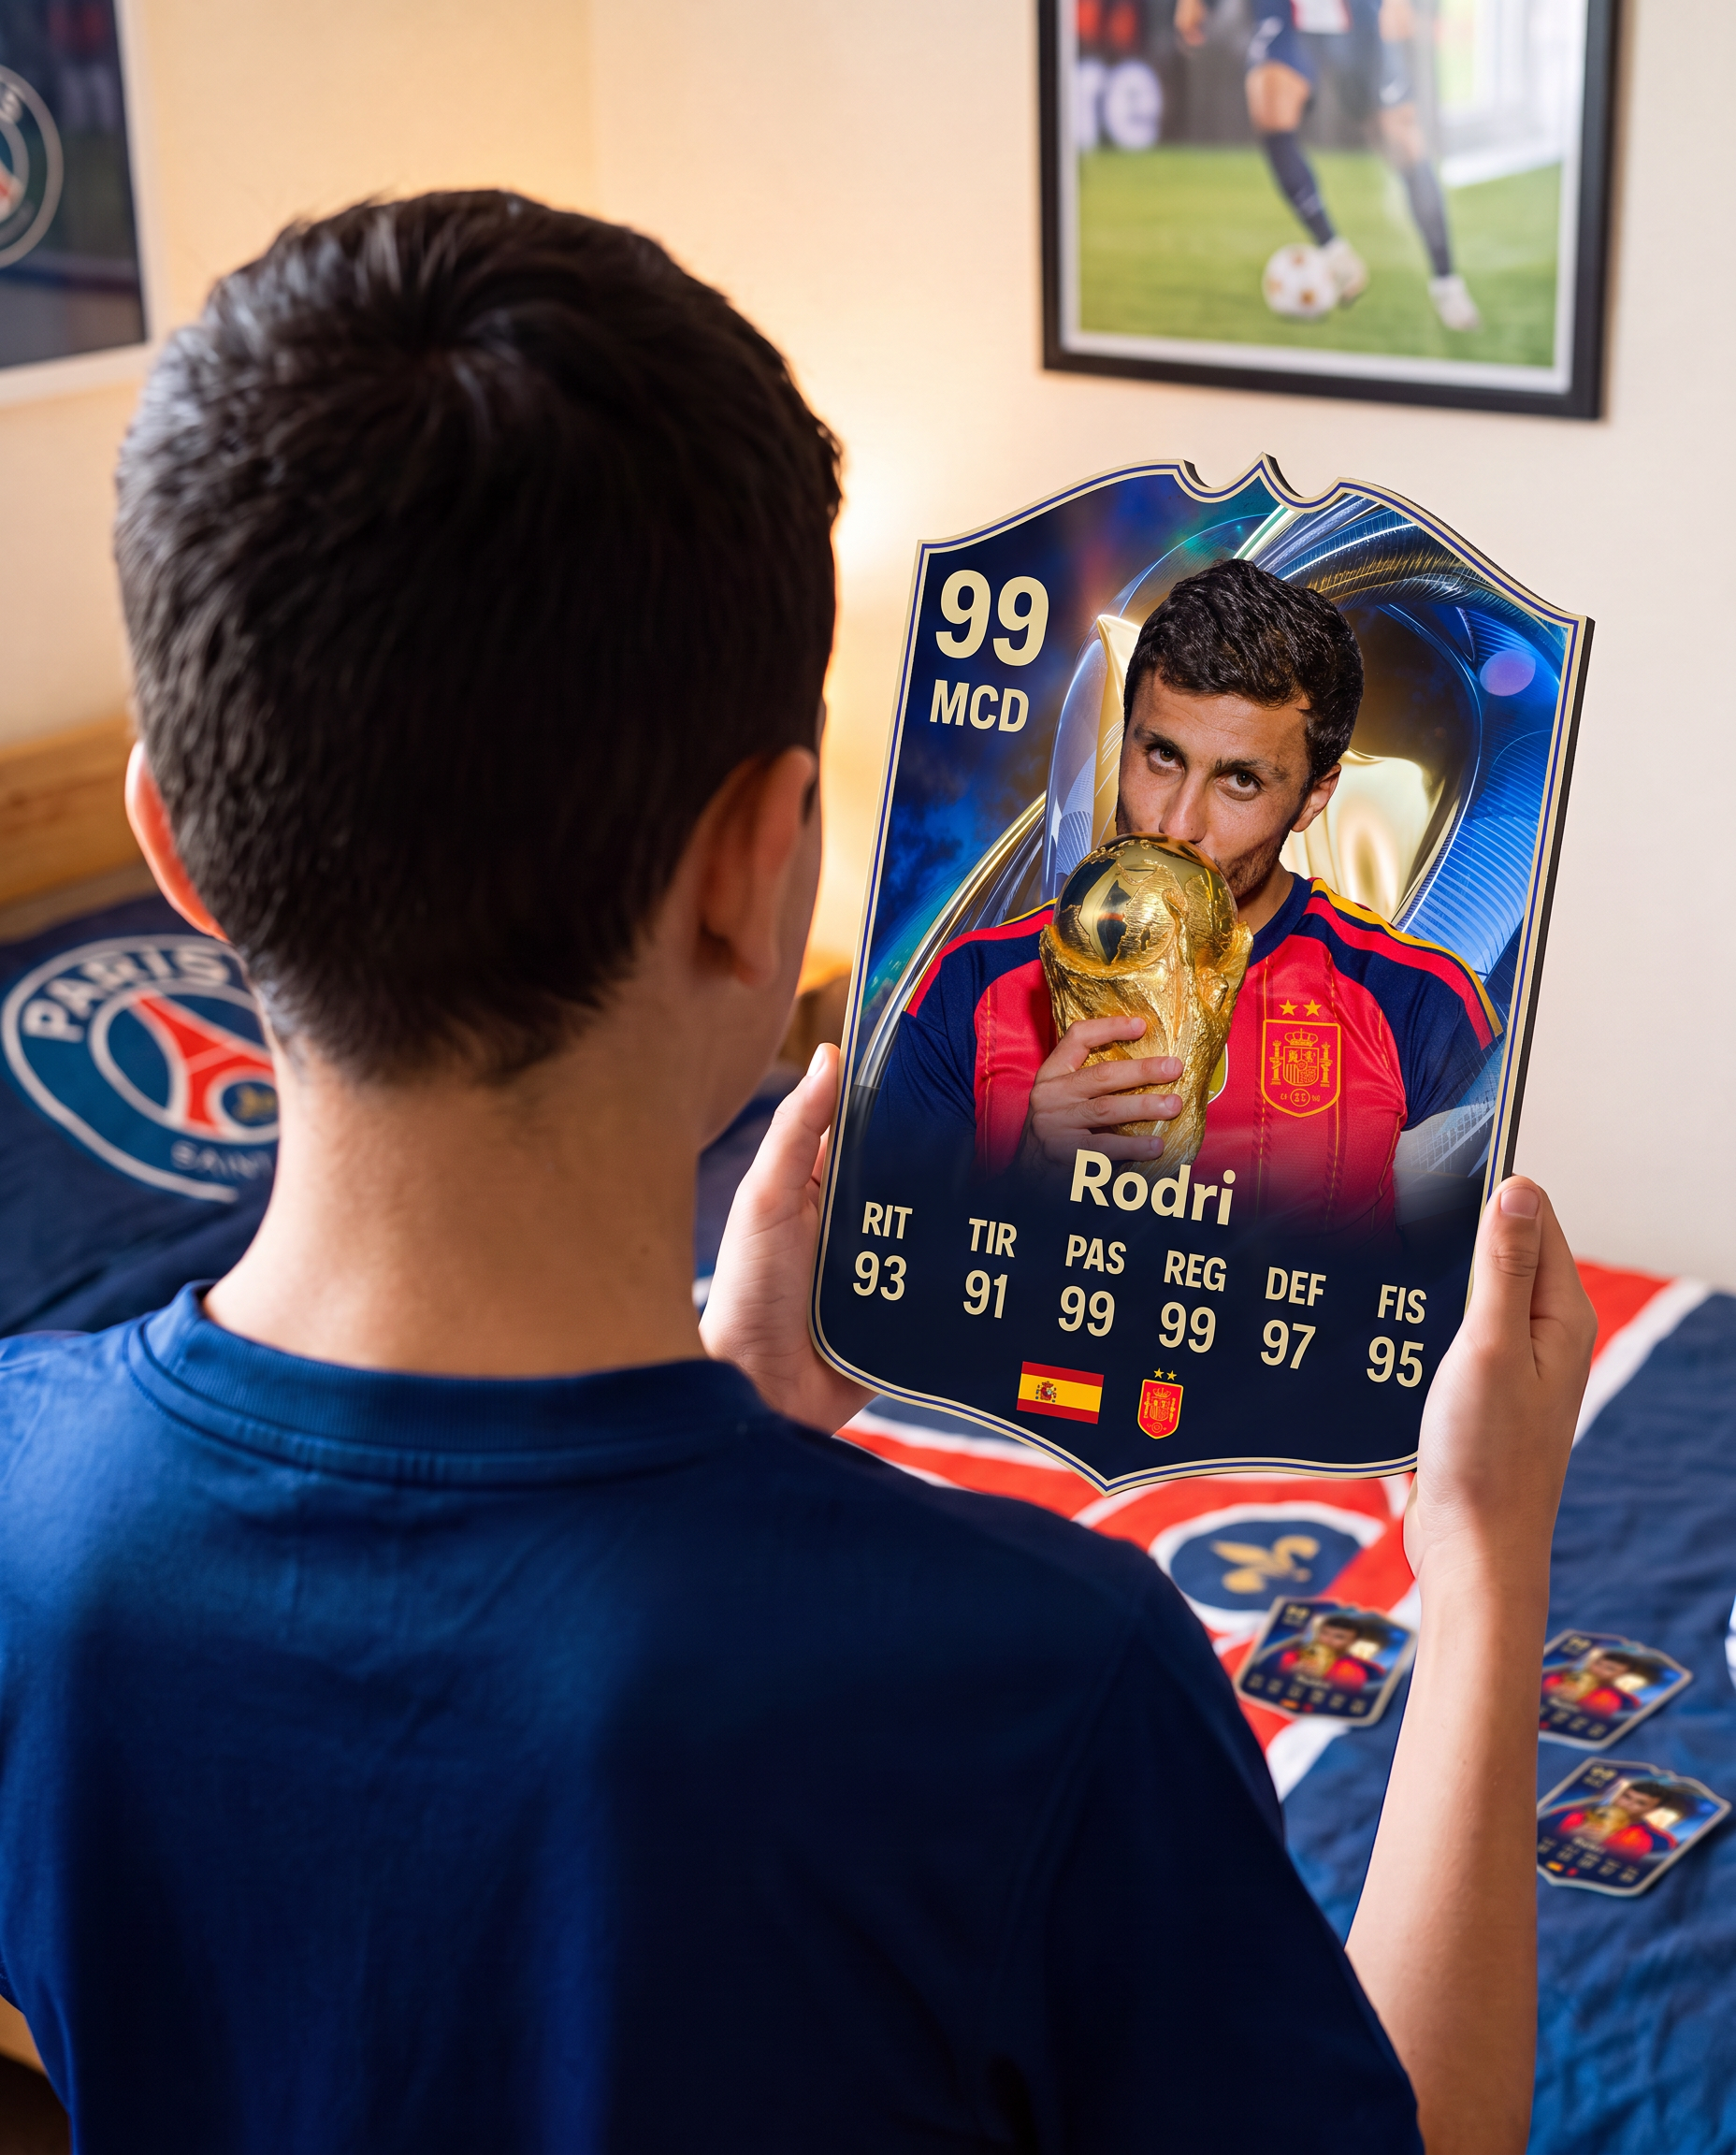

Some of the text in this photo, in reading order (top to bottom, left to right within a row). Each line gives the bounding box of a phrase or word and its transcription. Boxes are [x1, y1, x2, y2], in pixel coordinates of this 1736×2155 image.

[935, 570, 1049, 667] 99
[930, 679, 1029, 732] MCD
[22, 944, 230, 1043] PARIS
[1070, 1149, 1237, 1226] Rodri
[861, 1201, 1426, 1324] RIT TIR PAS REG DEF FIS
[852, 1251, 1425, 1388] 93 91 99 99 97 95
